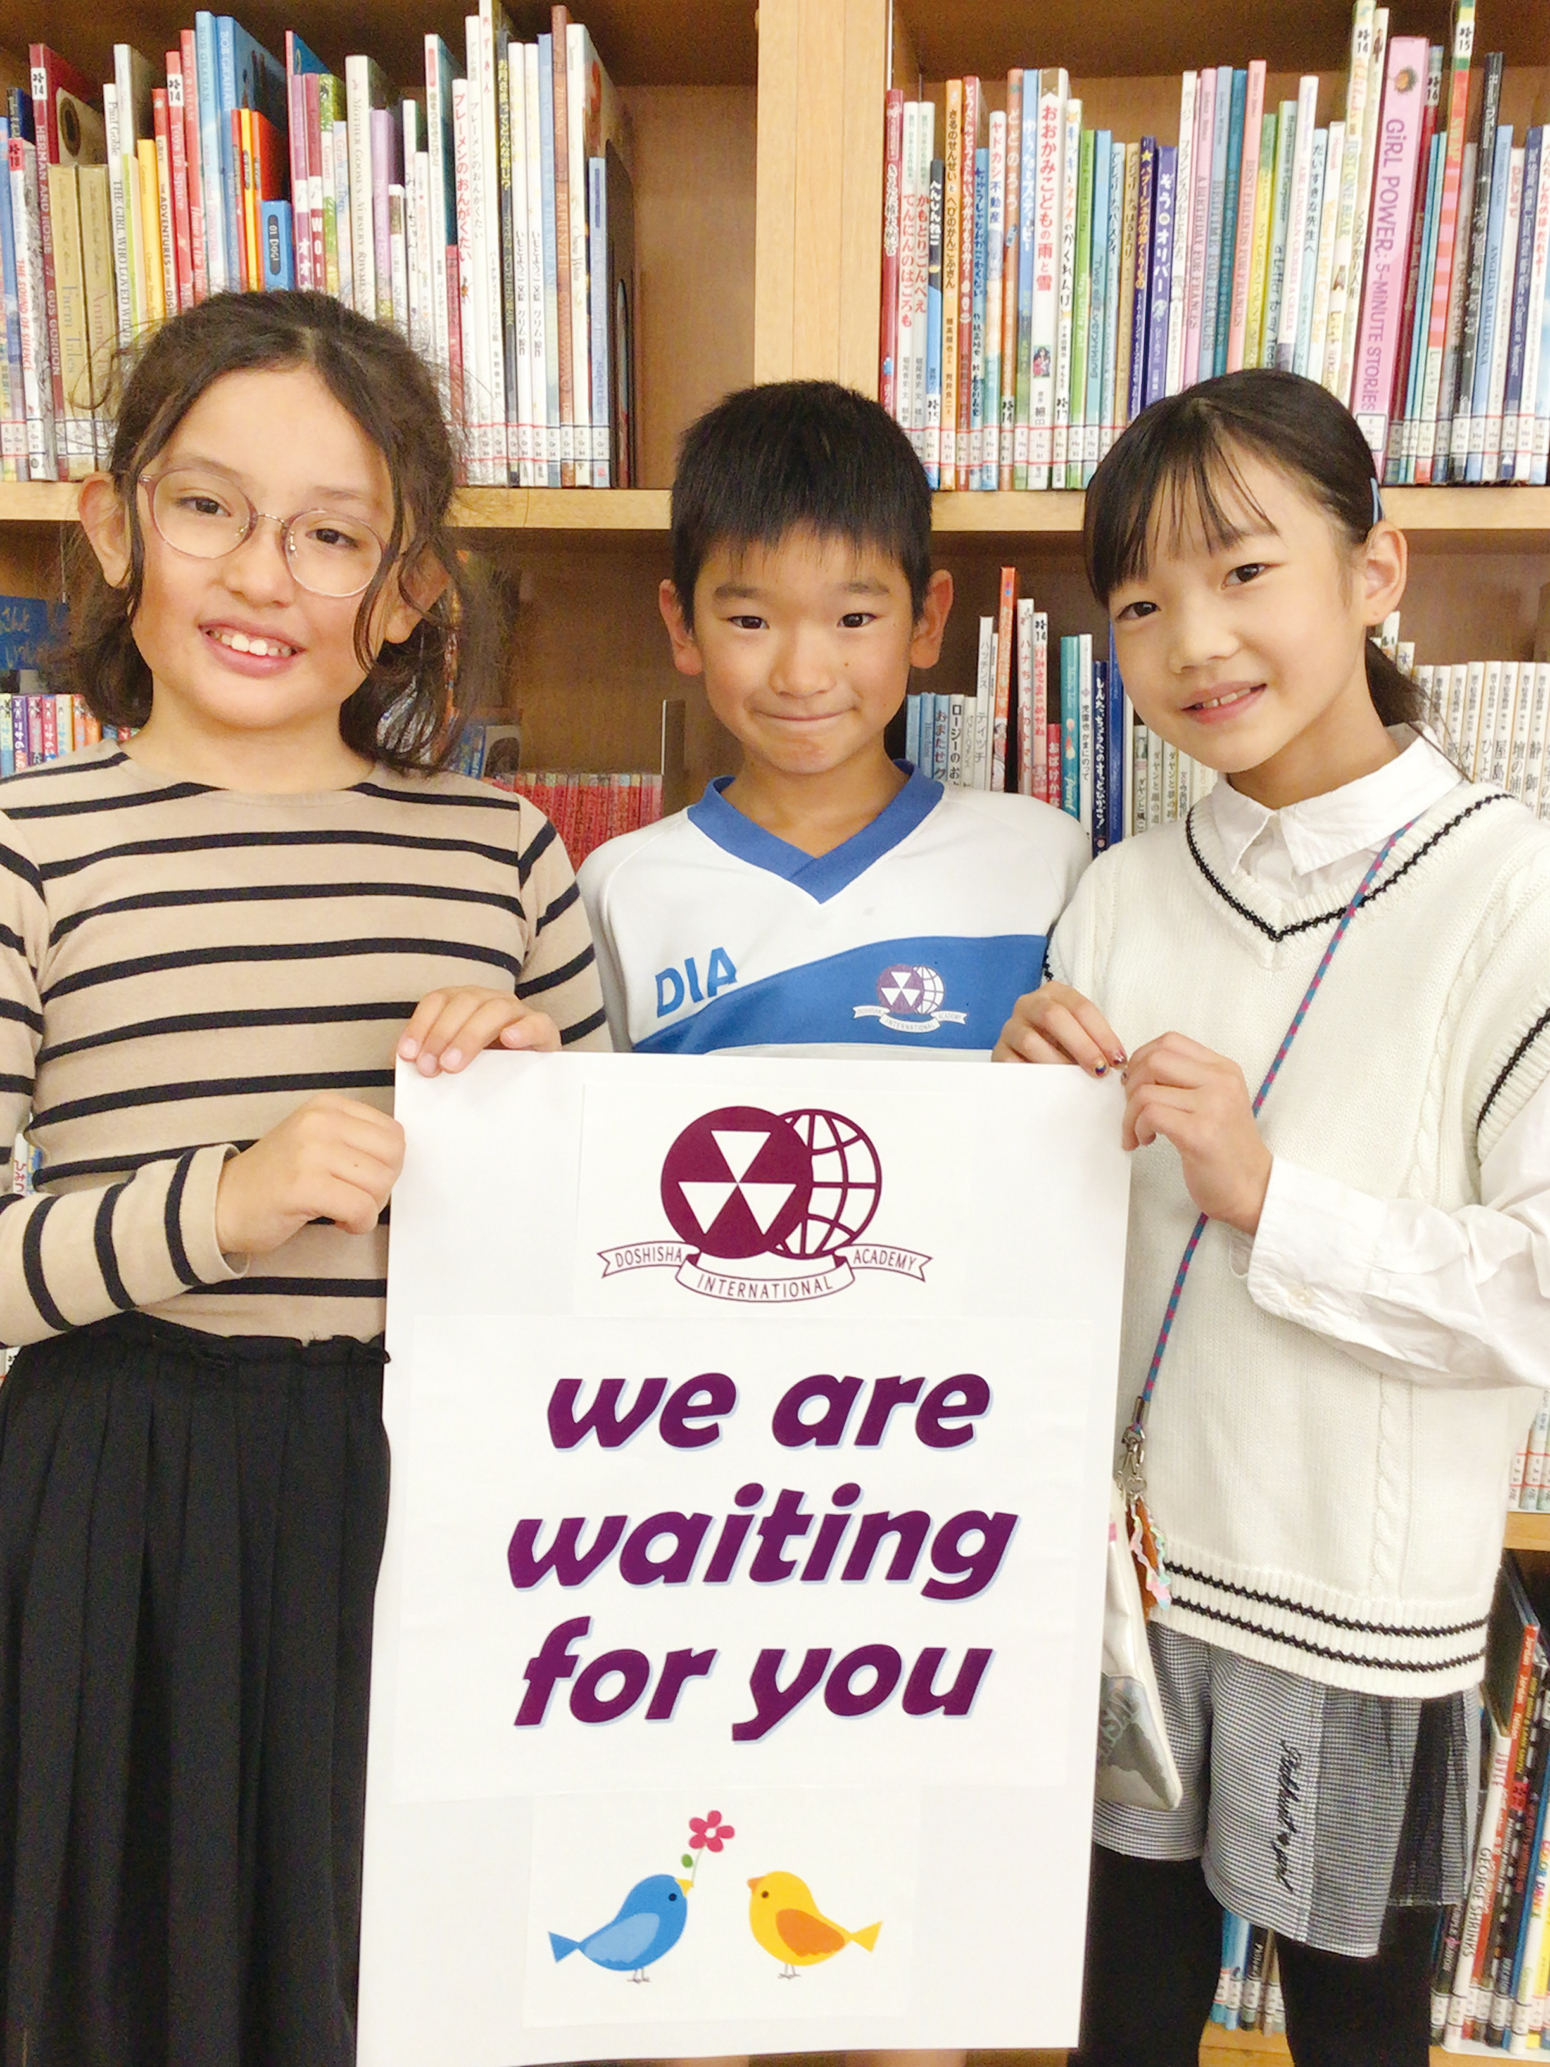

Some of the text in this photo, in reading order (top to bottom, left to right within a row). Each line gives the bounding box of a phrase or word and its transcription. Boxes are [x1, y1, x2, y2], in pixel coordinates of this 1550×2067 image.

[108, 101, 119, 124] Paul
[184, 70, 194, 121] GRAHAM
[221, 57, 232, 112] GRAHAM
[36, 125, 48, 180] HERMAN
[110, 126, 121, 157] Goble
[352, 97, 362, 146] MOTHER
[170, 121, 184, 210] Toys in Space
[453, 93, 473, 263] ブレーメンのおんがくたい
[989, 121, 1003, 223] ヤドカシ不動産
[1346, 140, 1359, 168] JUST
[39, 184, 50, 213] AND
[113, 180, 123, 199] THE
[929, 180, 942, 246] へんしんねこ
[1036, 104, 1059, 291] おおかみこどもの雨と雪
[1292, 190, 1306, 236] LINCOLN
[1304, 144, 1323, 252] だいすきな先生へ
[1344, 171, 1356, 202] ONE
[1373, 175, 1401, 259] POWER:
[114, 204, 126, 235] GIRL
[116, 237, 128, 263] WHO
[160, 196, 171, 266] ADVENTURES
[556, 193, 569, 271] RAPUNZEL
[1154, 173, 1175, 293] ぞうのオリバー
[1234, 159, 1257, 328] BEST FRIENDS FOR FRANCES
[900, 193, 914, 328] てんにんのはごろも
[914, 193, 930, 314] かもとりごんべえ
[1092, 255, 1103, 285] Two
[1202, 180, 1223, 351] BEDTIME FOR FRANCES
[1289, 239, 1303, 286] CROSSES
[47, 290, 57, 317] GUS
[117, 266, 130, 304] LOVED
[1189, 276, 1201, 329] FRANCES
[1479, 244, 1499, 366] ANGELINA BALLERINA
[49, 320, 61, 376] GORDON
[1089, 305, 1103, 379] Everything
[1019, 639, 1033, 773] ハナちゃんのトマト
[949, 704, 963, 780] ロージーのお
[655, 946, 738, 1019] DIA
[614, 1246, 918, 1300] DOSHISHA INTERNATIONAL ACADEMY
[547, 1372, 992, 1452] we are
[506, 1482, 1020, 1604] waiting
[513, 1615, 995, 1744] for you
[1471, 1847, 1491, 1899] GEORGE
[1461, 1900, 1483, 1958] SHRINKS
